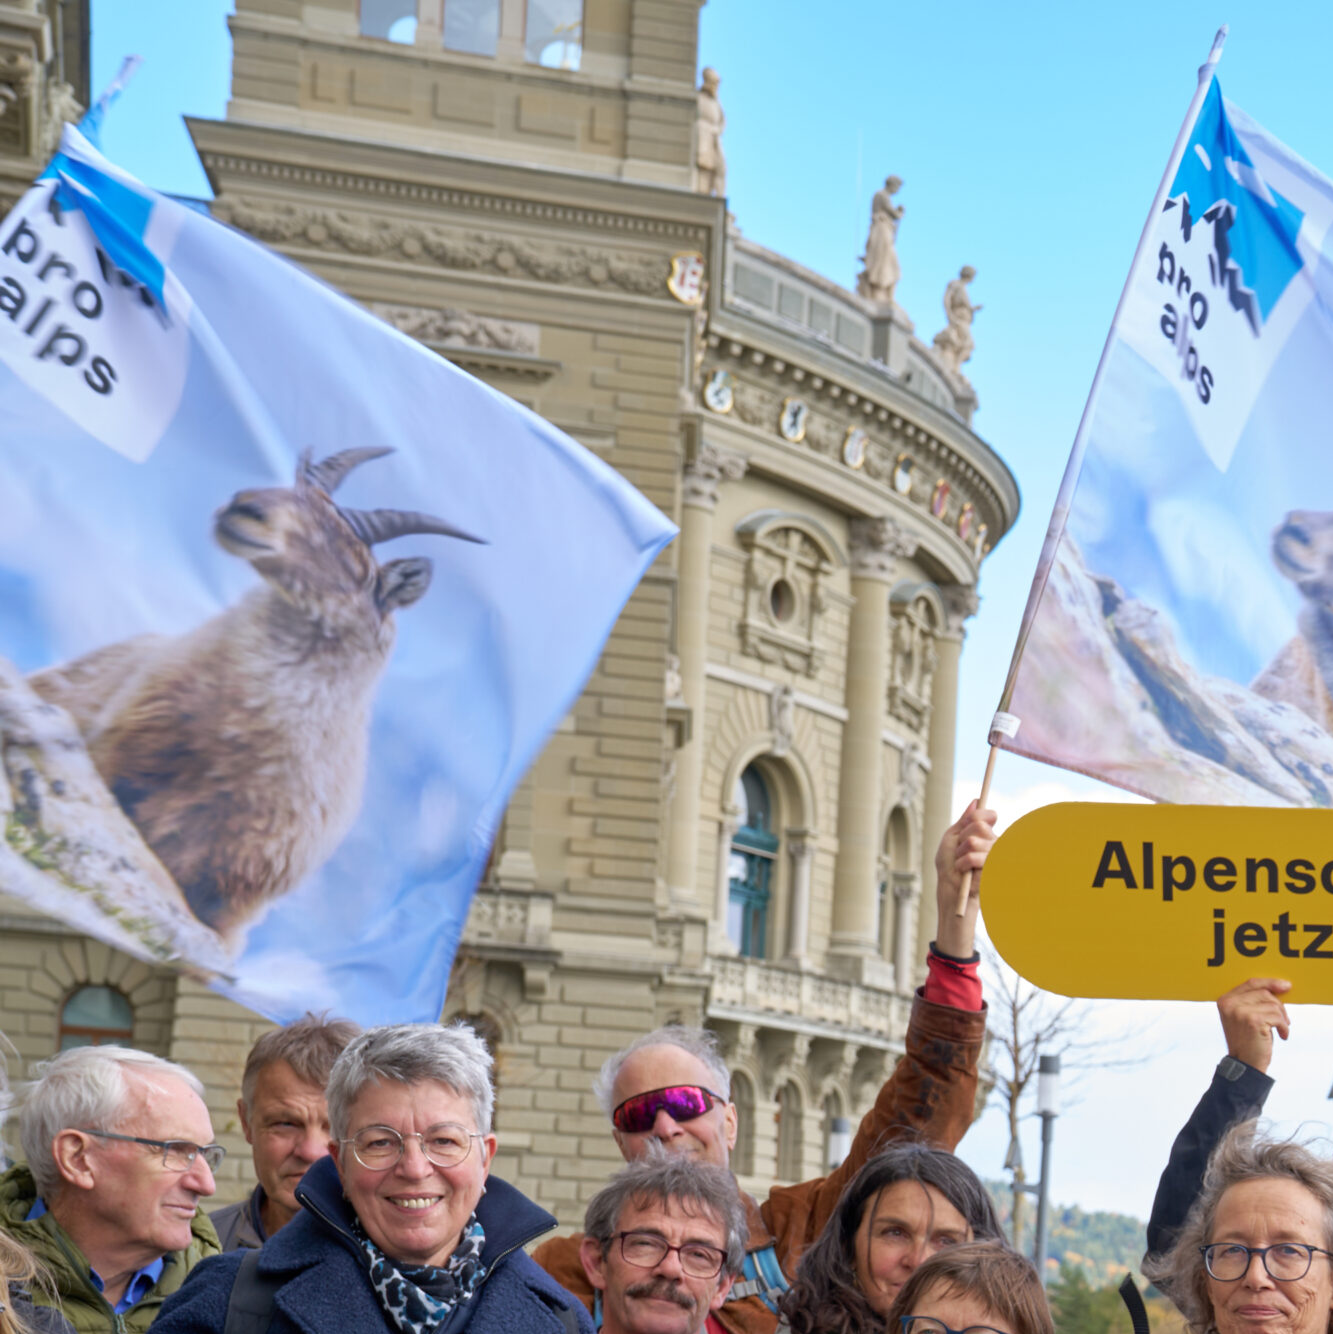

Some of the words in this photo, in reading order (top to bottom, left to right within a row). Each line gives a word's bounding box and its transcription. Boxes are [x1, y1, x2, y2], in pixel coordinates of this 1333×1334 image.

[1, 218, 104, 319] pro
[1157, 241, 1209, 330] pro
[0, 276, 118, 396] alps
[1160, 303, 1214, 405] alps
